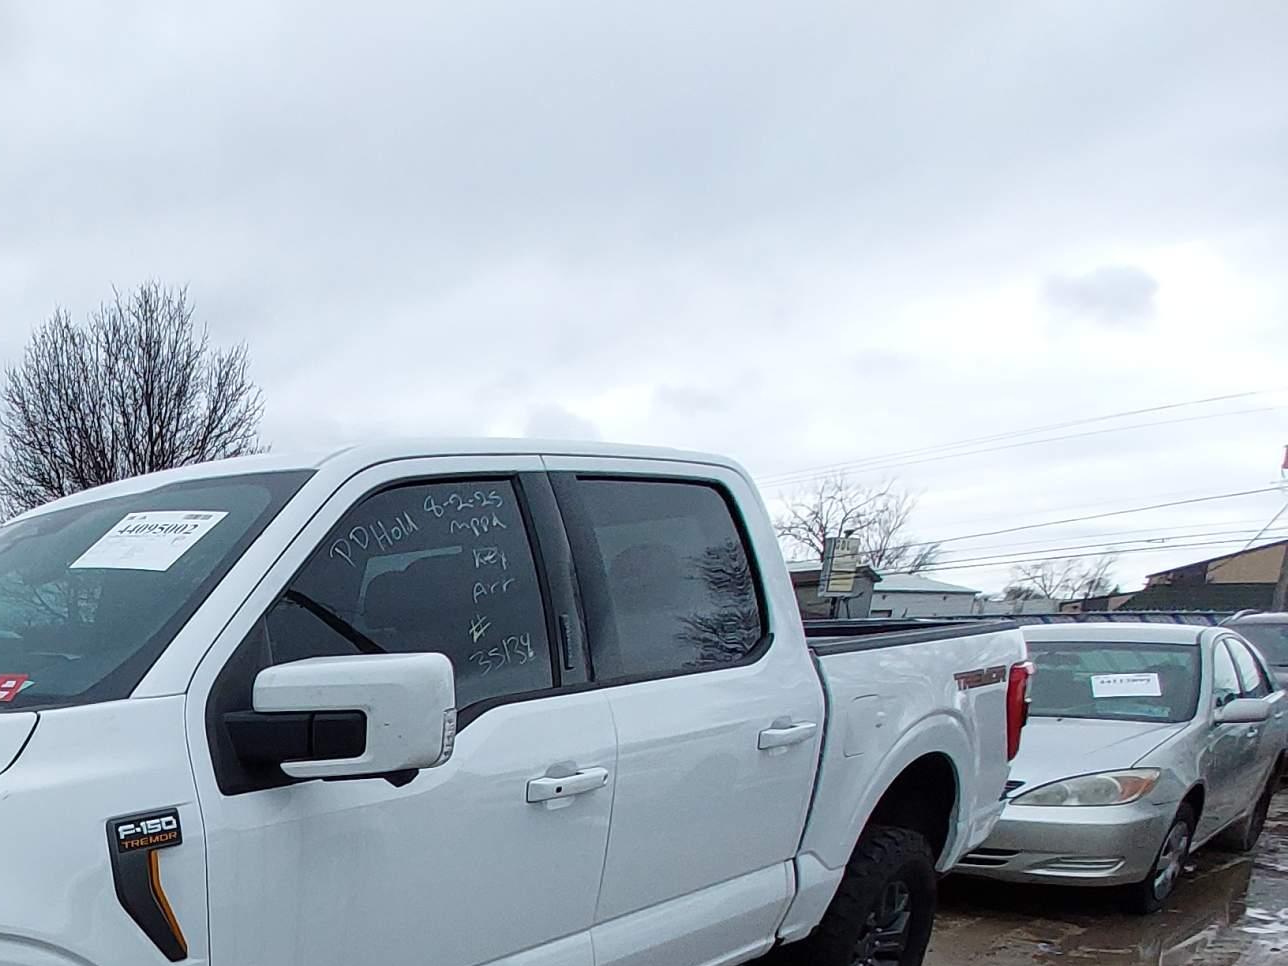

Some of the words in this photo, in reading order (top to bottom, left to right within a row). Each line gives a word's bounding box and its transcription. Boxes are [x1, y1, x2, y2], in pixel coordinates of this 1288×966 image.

[117, 523, 199, 534] 44095002
[119, 817, 177, 839] F-150
[122, 832, 177, 849] TREMOR
